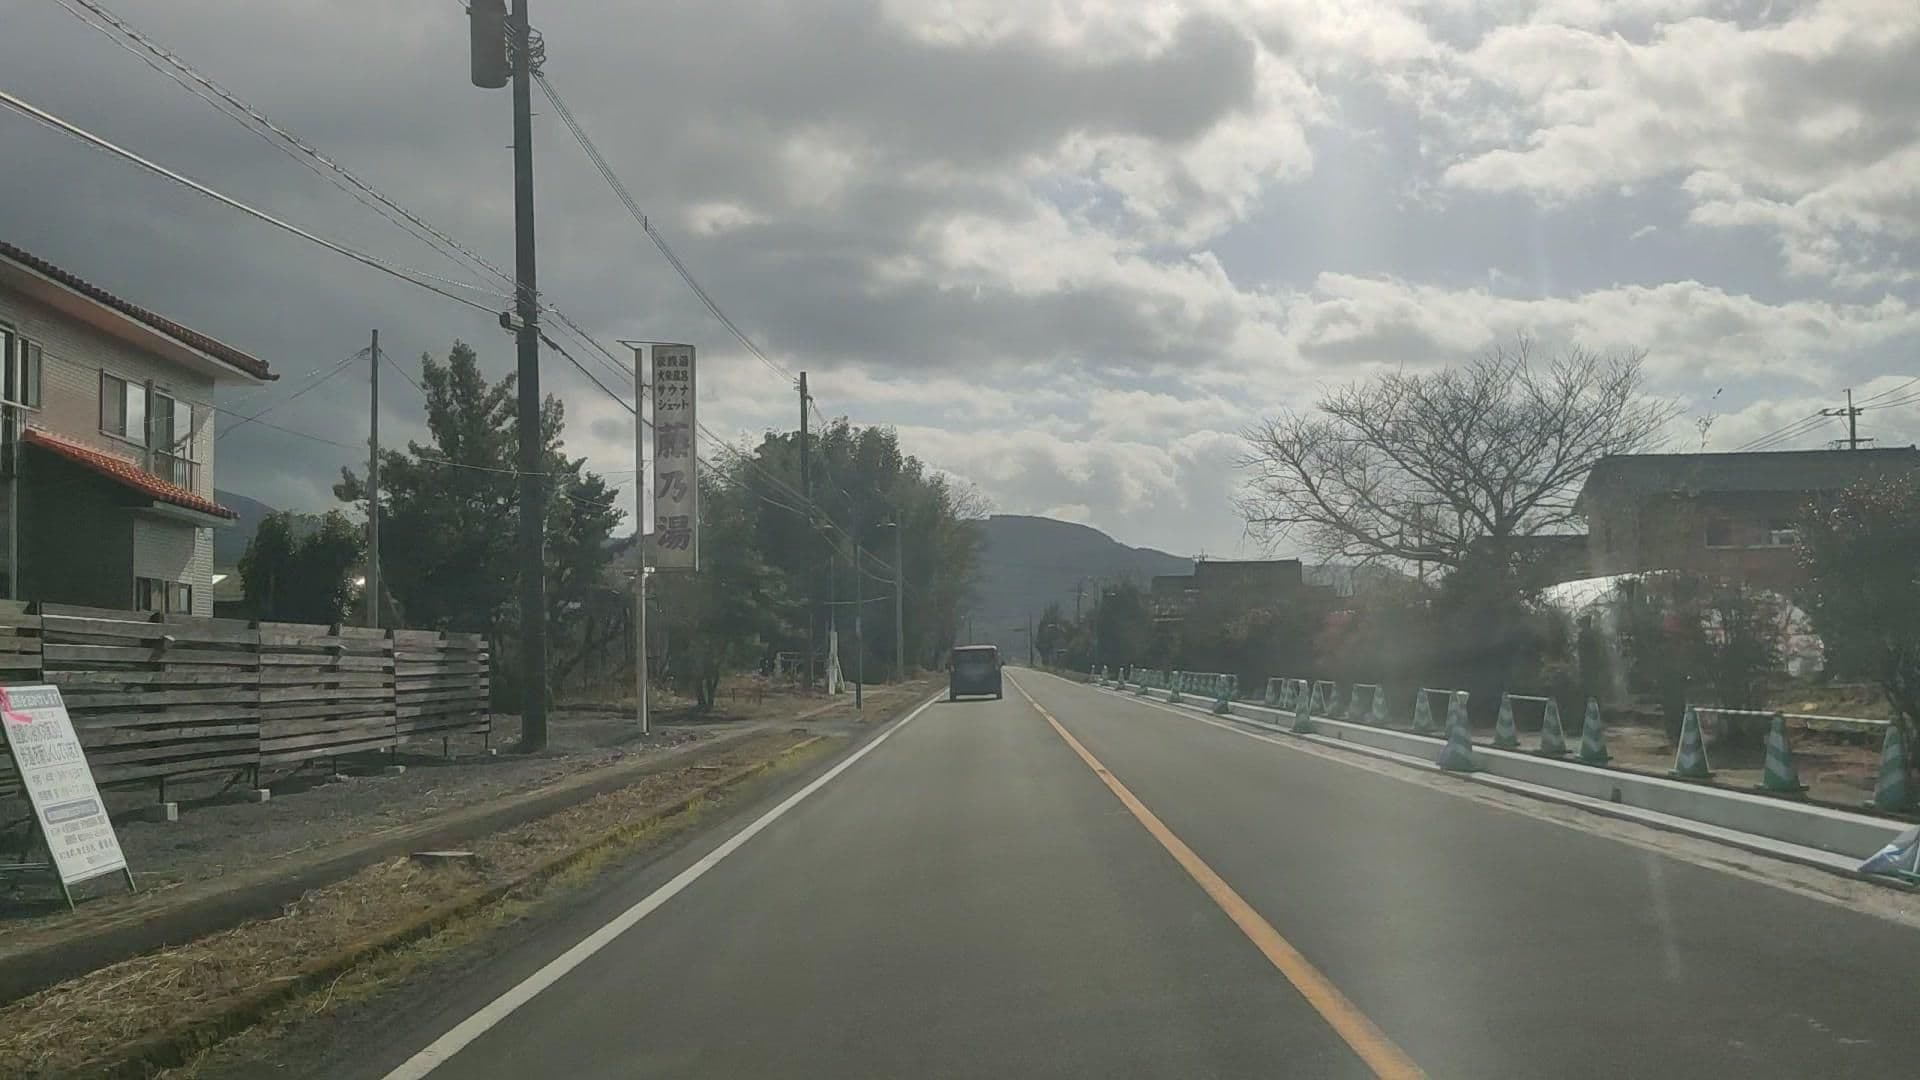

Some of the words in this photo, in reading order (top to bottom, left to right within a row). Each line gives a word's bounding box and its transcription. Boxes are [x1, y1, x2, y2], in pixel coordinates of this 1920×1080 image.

[657, 384, 689, 397] サウナ
[656, 399, 689, 411] ジェット
